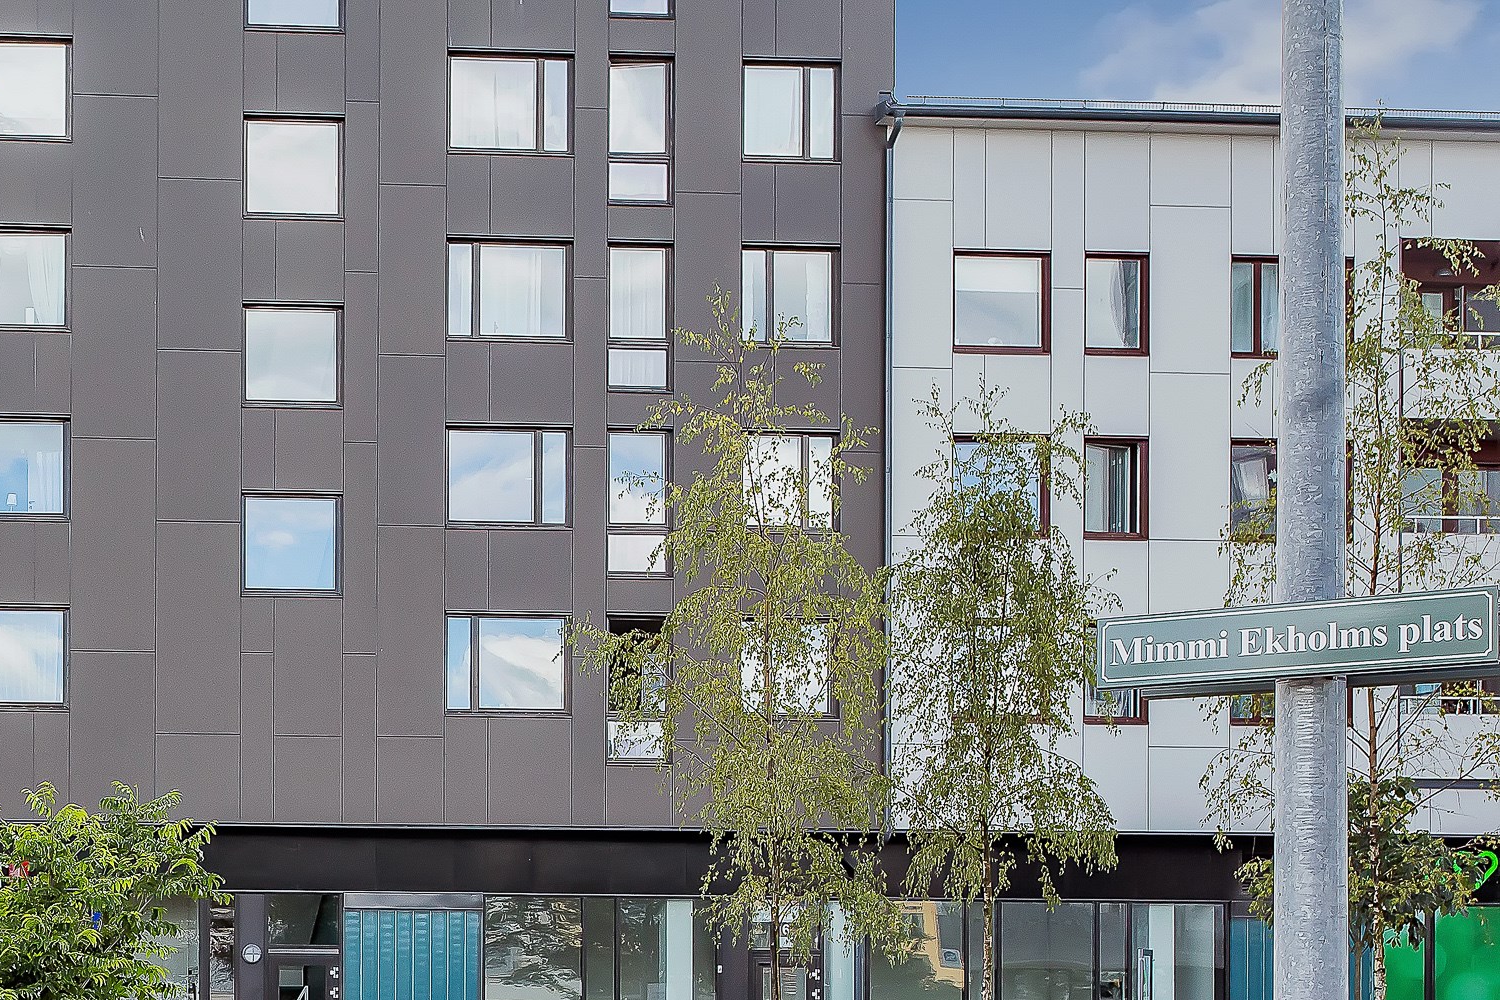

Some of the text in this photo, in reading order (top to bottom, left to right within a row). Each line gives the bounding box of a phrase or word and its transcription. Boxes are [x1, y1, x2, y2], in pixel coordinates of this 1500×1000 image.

[1109, 613, 1484, 667] Mimmi Ekholms plats
